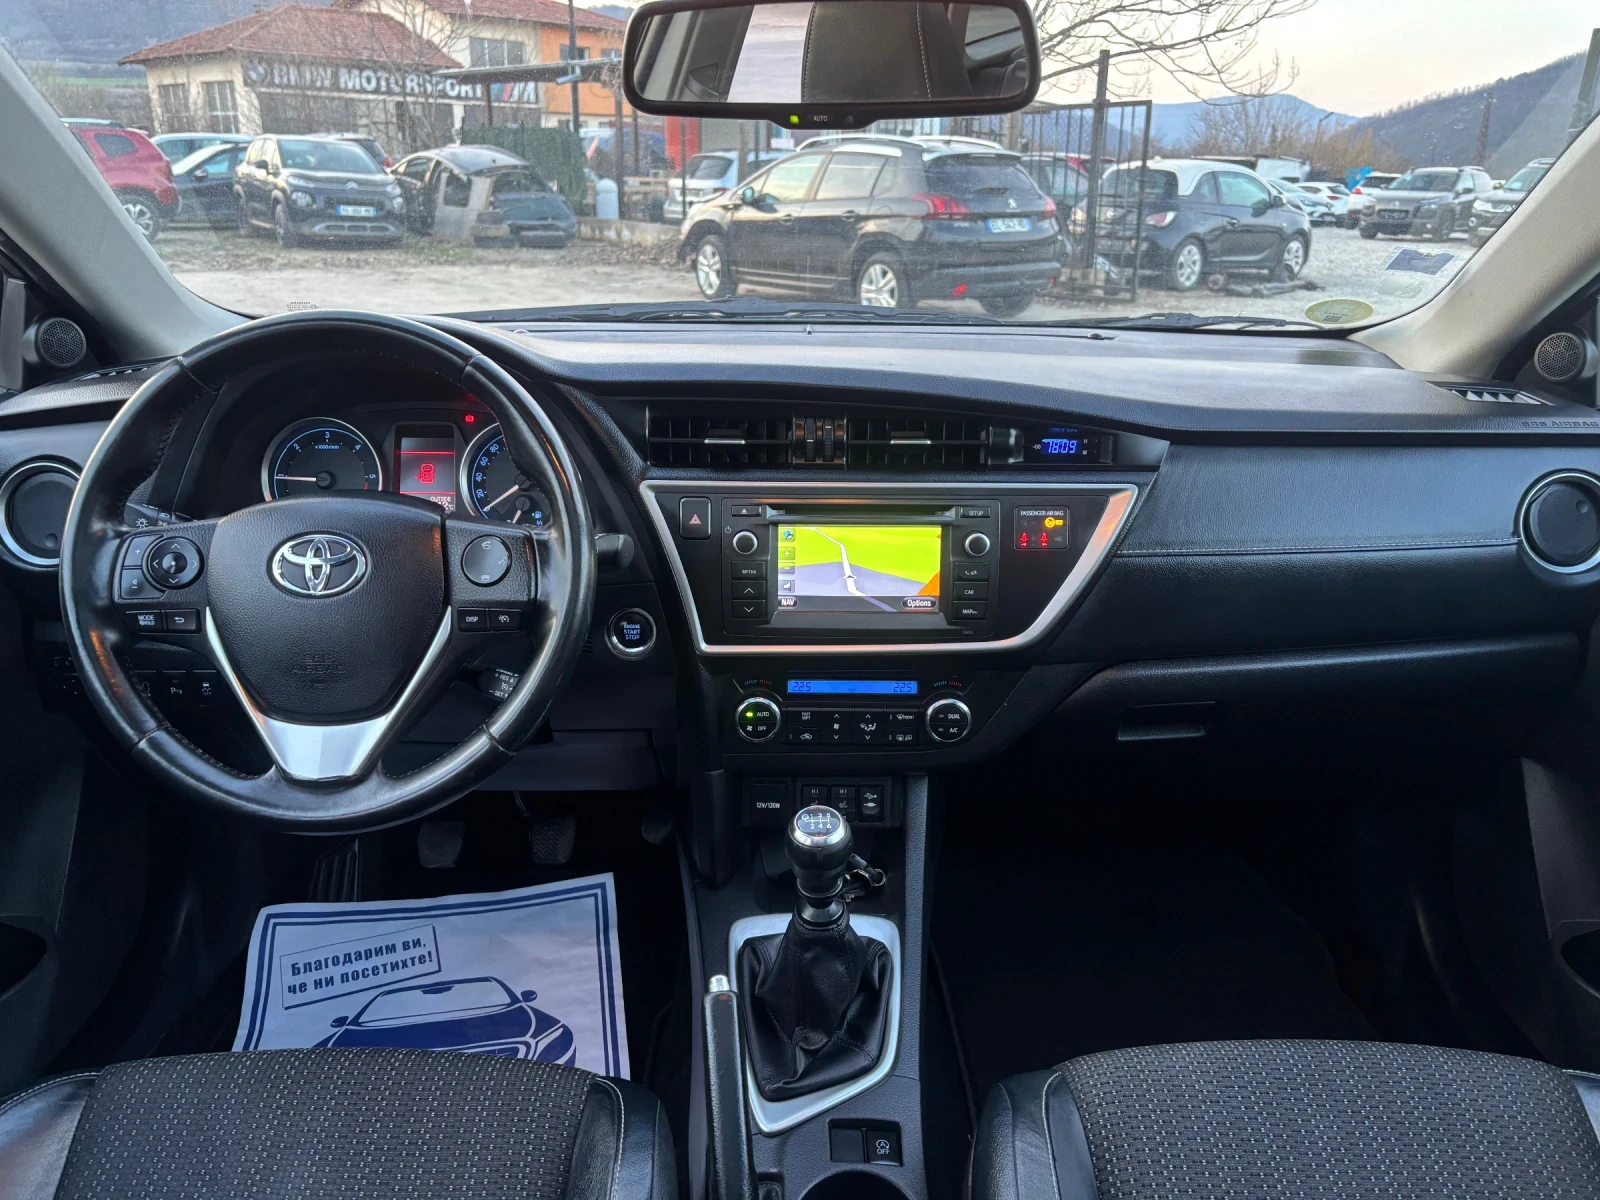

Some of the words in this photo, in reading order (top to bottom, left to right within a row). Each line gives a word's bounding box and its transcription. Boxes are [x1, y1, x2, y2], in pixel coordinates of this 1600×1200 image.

[324, 431, 331, 439] 3
[293, 443, 301, 451] 2
[489, 443, 499, 453] 80
[480, 456, 489, 466] 60
[475, 472, 483, 482] 40
[476, 489, 485, 498] 20
[781, 598, 795, 606] NAV
[907, 599, 932, 608] Options
[792, 681, 812, 692] 22.5
[893, 682, 913, 693] 22.5
[291, 943, 397, 977] Благодарим
[402, 937, 427, 952] ви,
[287, 981, 308, 995] че
[313, 975, 335, 990] ни
[340, 950, 433, 984] посетихте!
